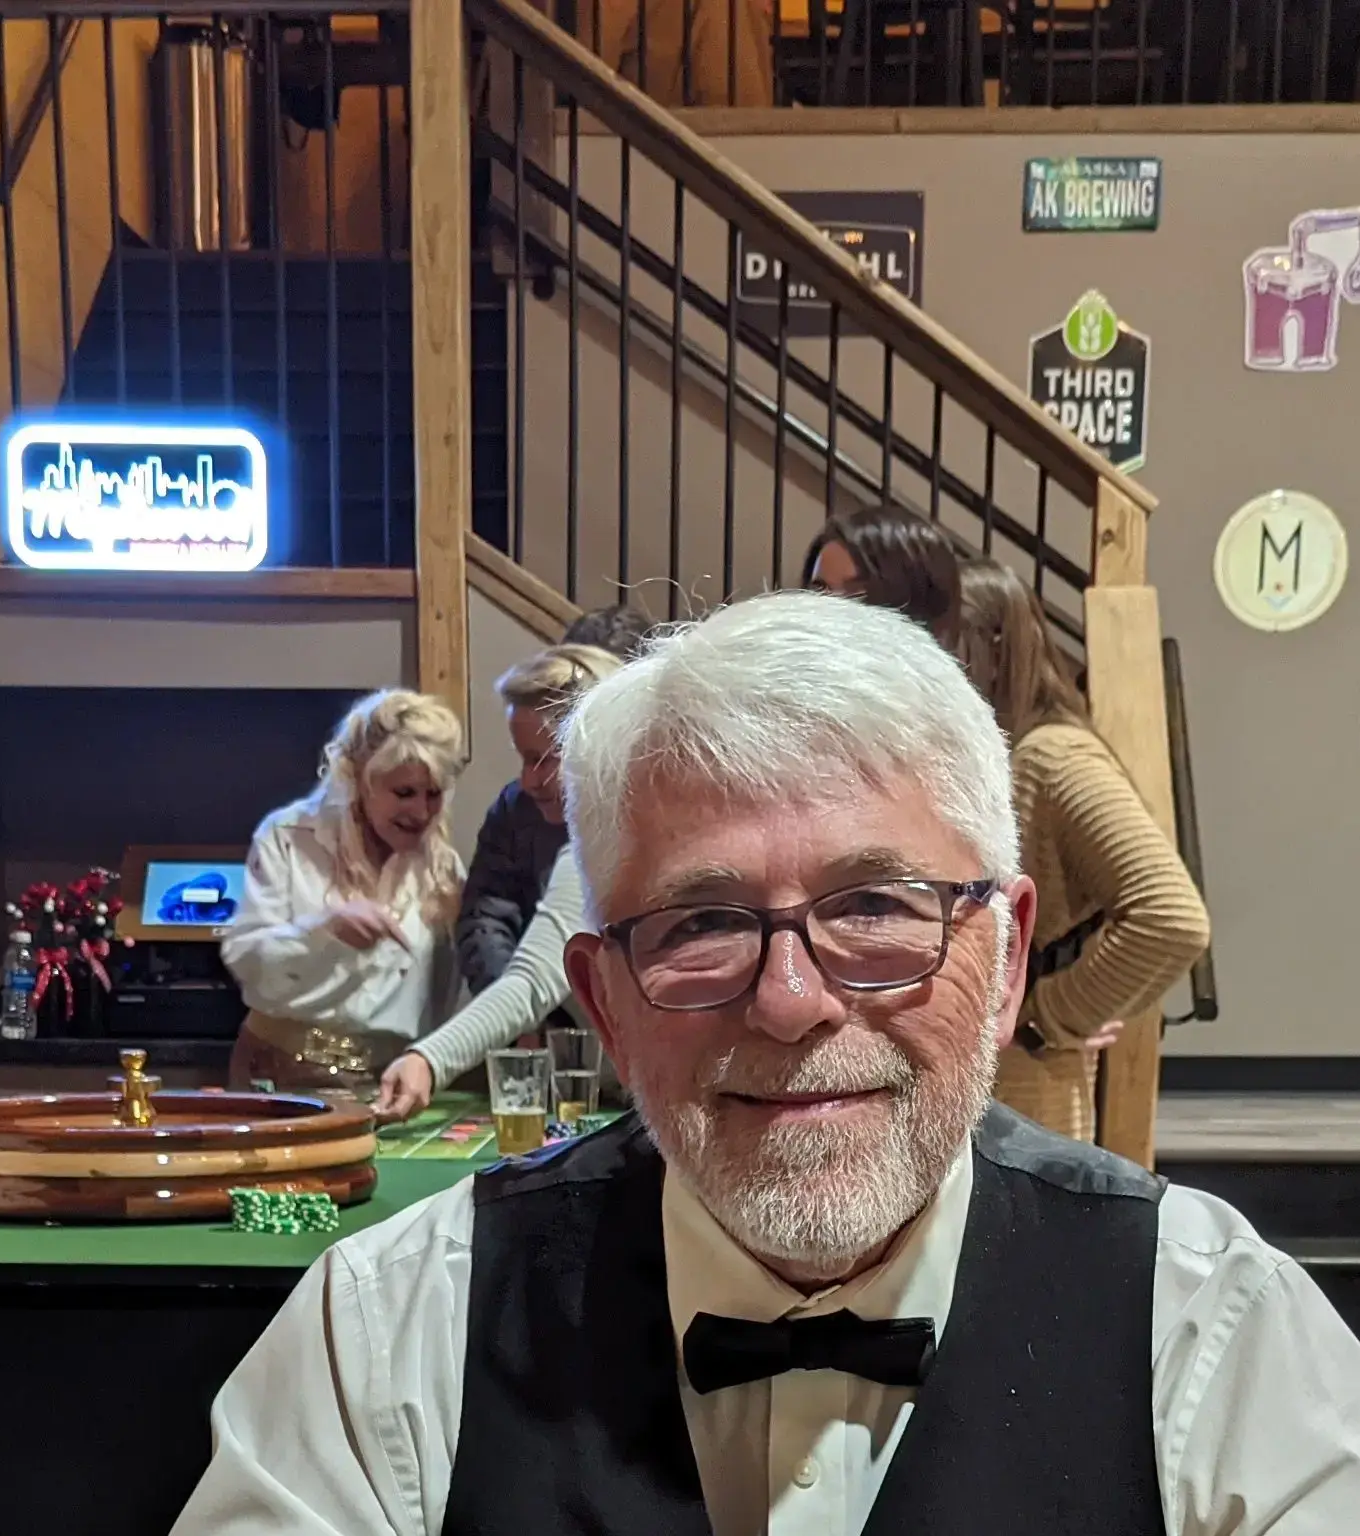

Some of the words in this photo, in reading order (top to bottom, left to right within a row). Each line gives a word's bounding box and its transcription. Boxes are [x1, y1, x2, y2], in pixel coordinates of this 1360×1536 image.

[1030, 180, 1058, 219] AK
[1063, 179, 1155, 219] BREWING
[1043, 367, 1135, 398] THIRD
[1257, 519, 1304, 593] M
